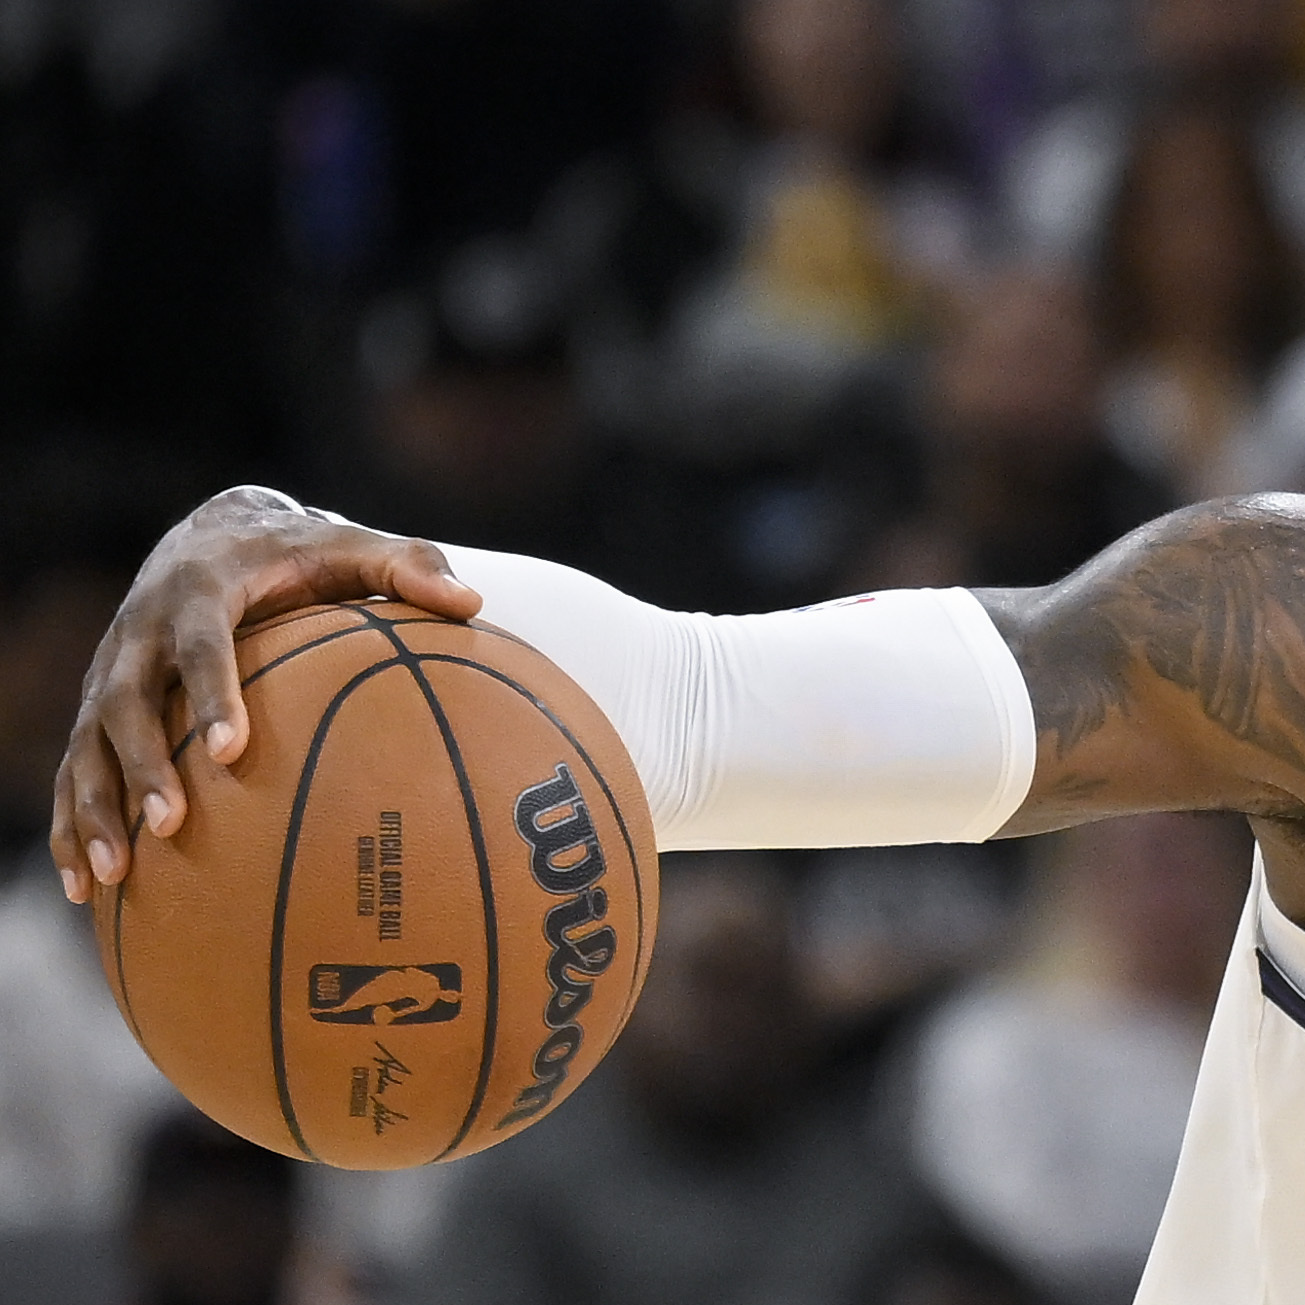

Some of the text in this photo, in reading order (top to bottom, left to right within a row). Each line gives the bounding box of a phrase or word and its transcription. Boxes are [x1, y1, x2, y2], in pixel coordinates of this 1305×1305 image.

[379, 811, 402, 942] OFFICIAL GAME BALL
[494, 762, 617, 1132] Wilson
